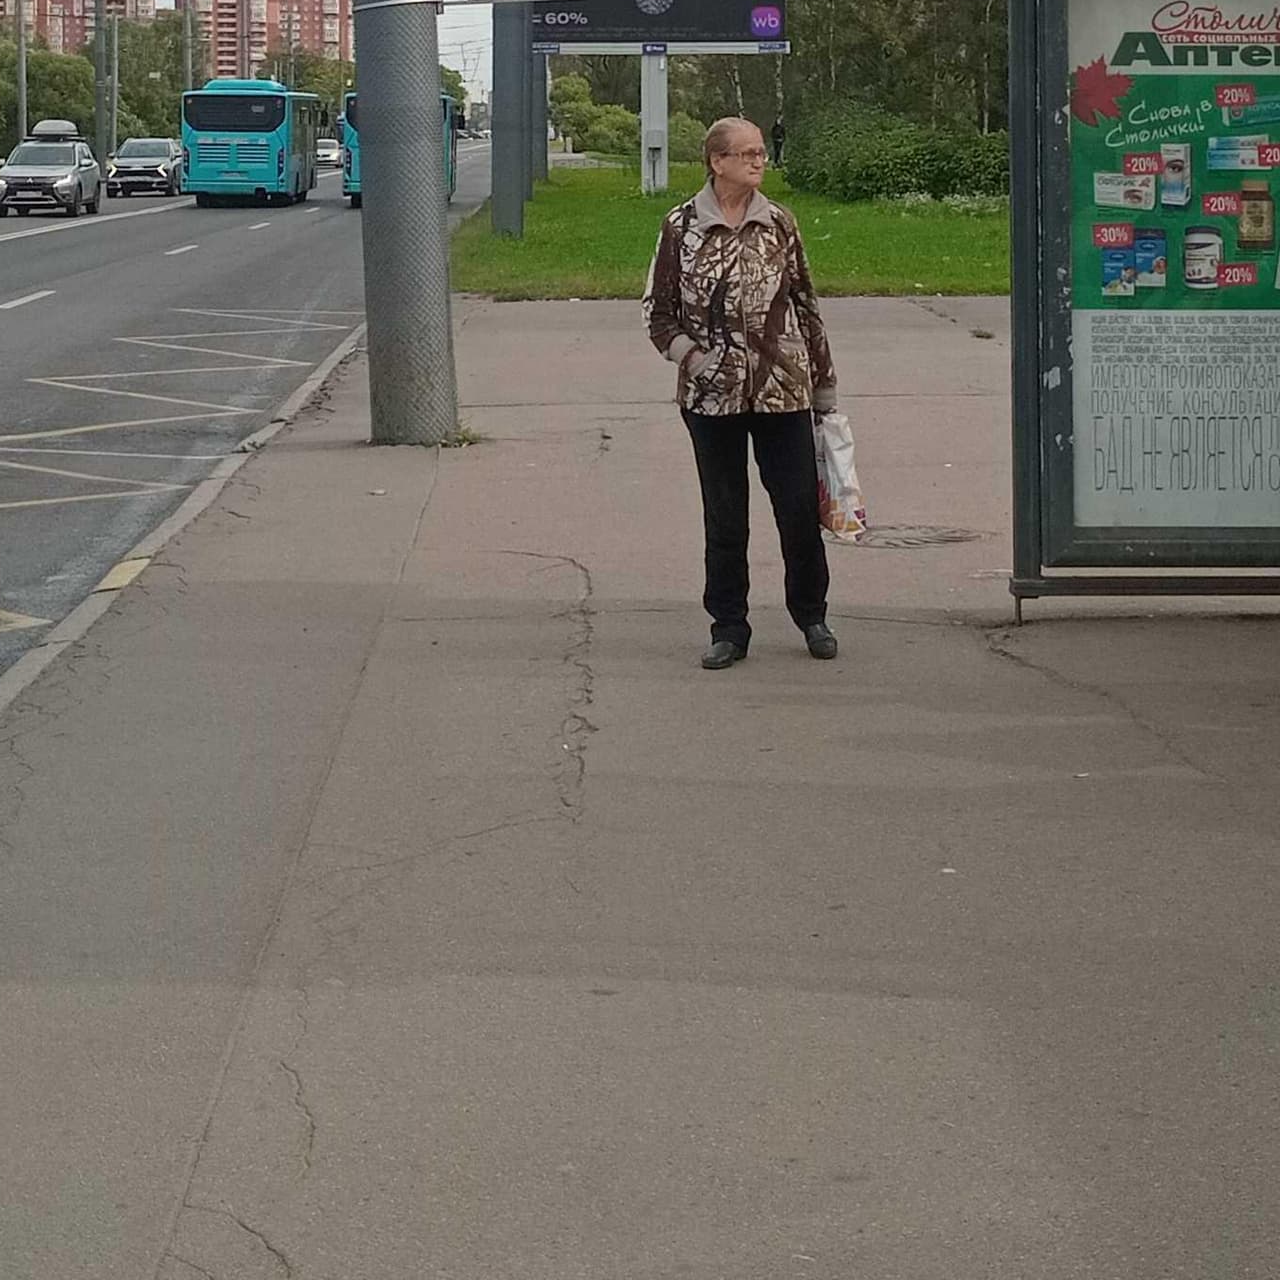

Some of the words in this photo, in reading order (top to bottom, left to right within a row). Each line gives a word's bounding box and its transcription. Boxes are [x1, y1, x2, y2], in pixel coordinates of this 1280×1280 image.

[545, 12, 588, 25] 60%
[752, 13, 780, 28] wb
[1162, 33, 1190, 44] сеть
[1193, 33, 1277, 45] социальных
[1218, 88, 1250, 104] -20%
[1126, 157, 1158, 172] -20%
[1204, 196, 1237, 212] -20%
[1096, 227, 1128, 243] -30%
[1220, 267, 1252, 283] -20%
[1091, 364, 1156, 389] ИМЕЮТСЯ
[1091, 390, 1173, 415] ПОЛУЧЕНИЕ
[1143, 416, 1163, 491] НЕ
[1170, 416, 1263, 491] ЯВЛЯЕТСЯ
